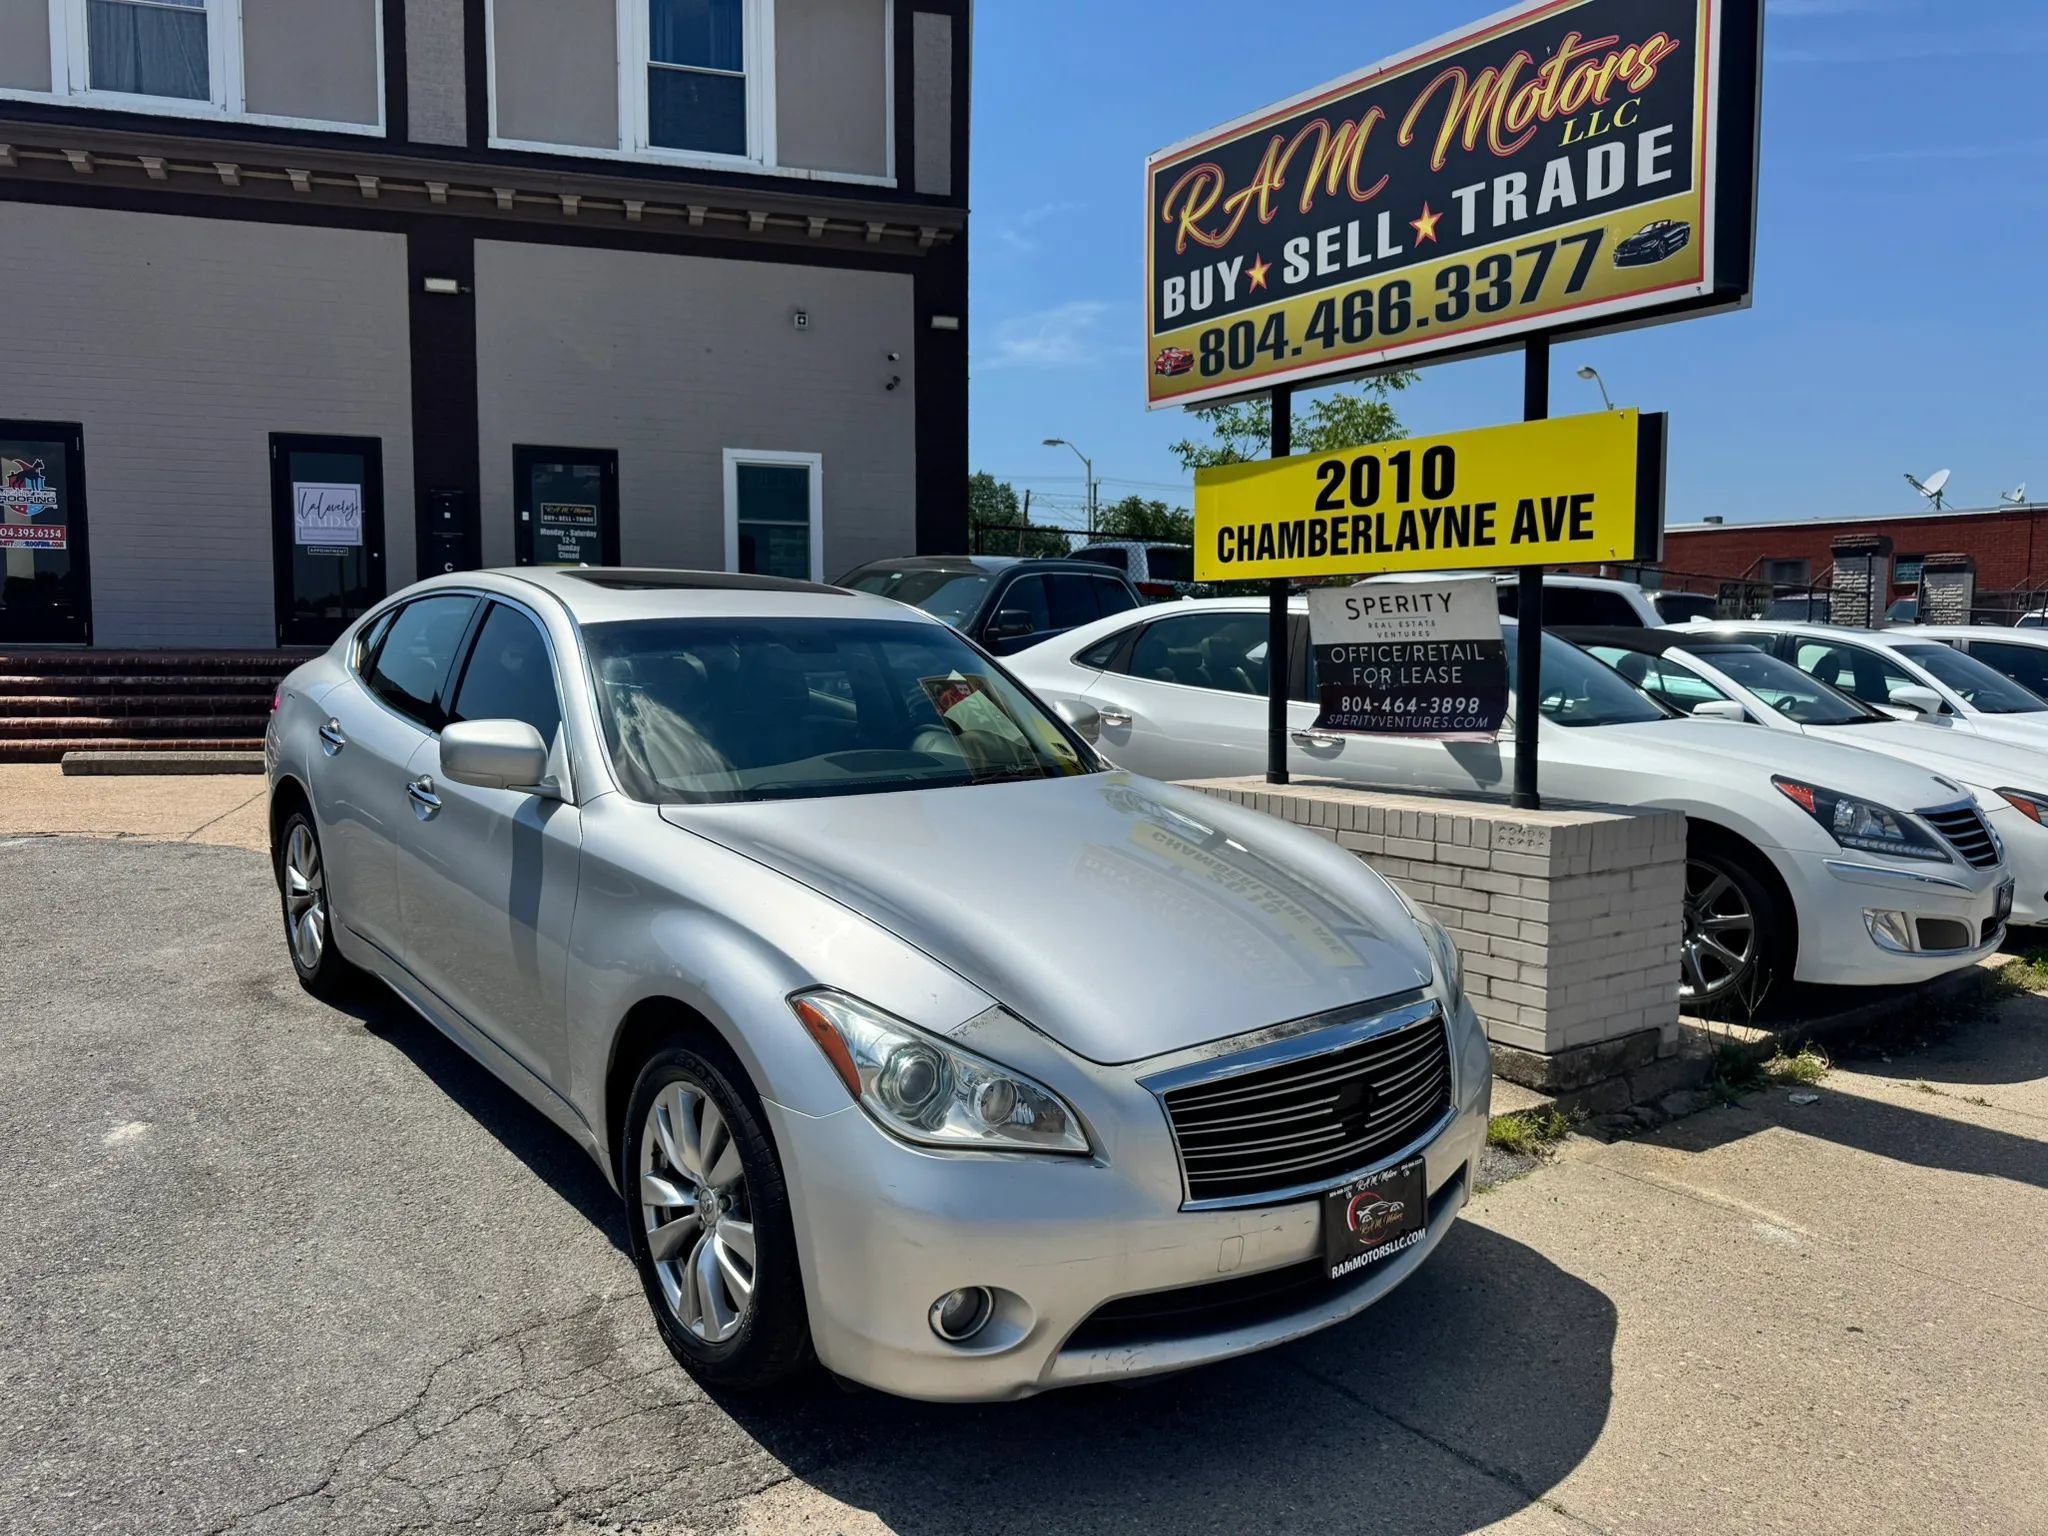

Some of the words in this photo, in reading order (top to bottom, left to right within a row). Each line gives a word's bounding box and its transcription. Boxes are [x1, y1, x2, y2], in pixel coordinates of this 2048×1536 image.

[1397, 31, 1681, 172] Motors
[1558, 97, 1642, 148] LLC
[1163, 255, 1244, 320] BUY
[1283, 210, 1403, 285] SELL
[1451, 124, 1674, 236] TRADE
[1198, 227, 1606, 378] 804.466.3377
[1315, 445, 1456, 512] 2010
[540, 528, 564, 536] Monday
[570, 529, 597, 538] Saturday
[1216, 502, 1497, 563] CHAMBERLAYNE
[1510, 493, 1595, 545] AVE
[444, 562, 454, 572] C
[1345, 592, 1452, 620] SPERITY
[1377, 630, 1431, 638] VENTURES
[1399, 620, 1437, 628] ESTATE
[1330, 643, 1486, 664] OFFICE/RETAIL
[1352, 666, 1392, 685] FOR
[1400, 666, 1464, 685] LEASE
[1341, 696, 1480, 714] 804-464-3898
[1327, 713, 1489, 729] SPERITYVENTURES.COM
[1331, 1228, 1427, 1279] RAMMOTORSLLC.COM
